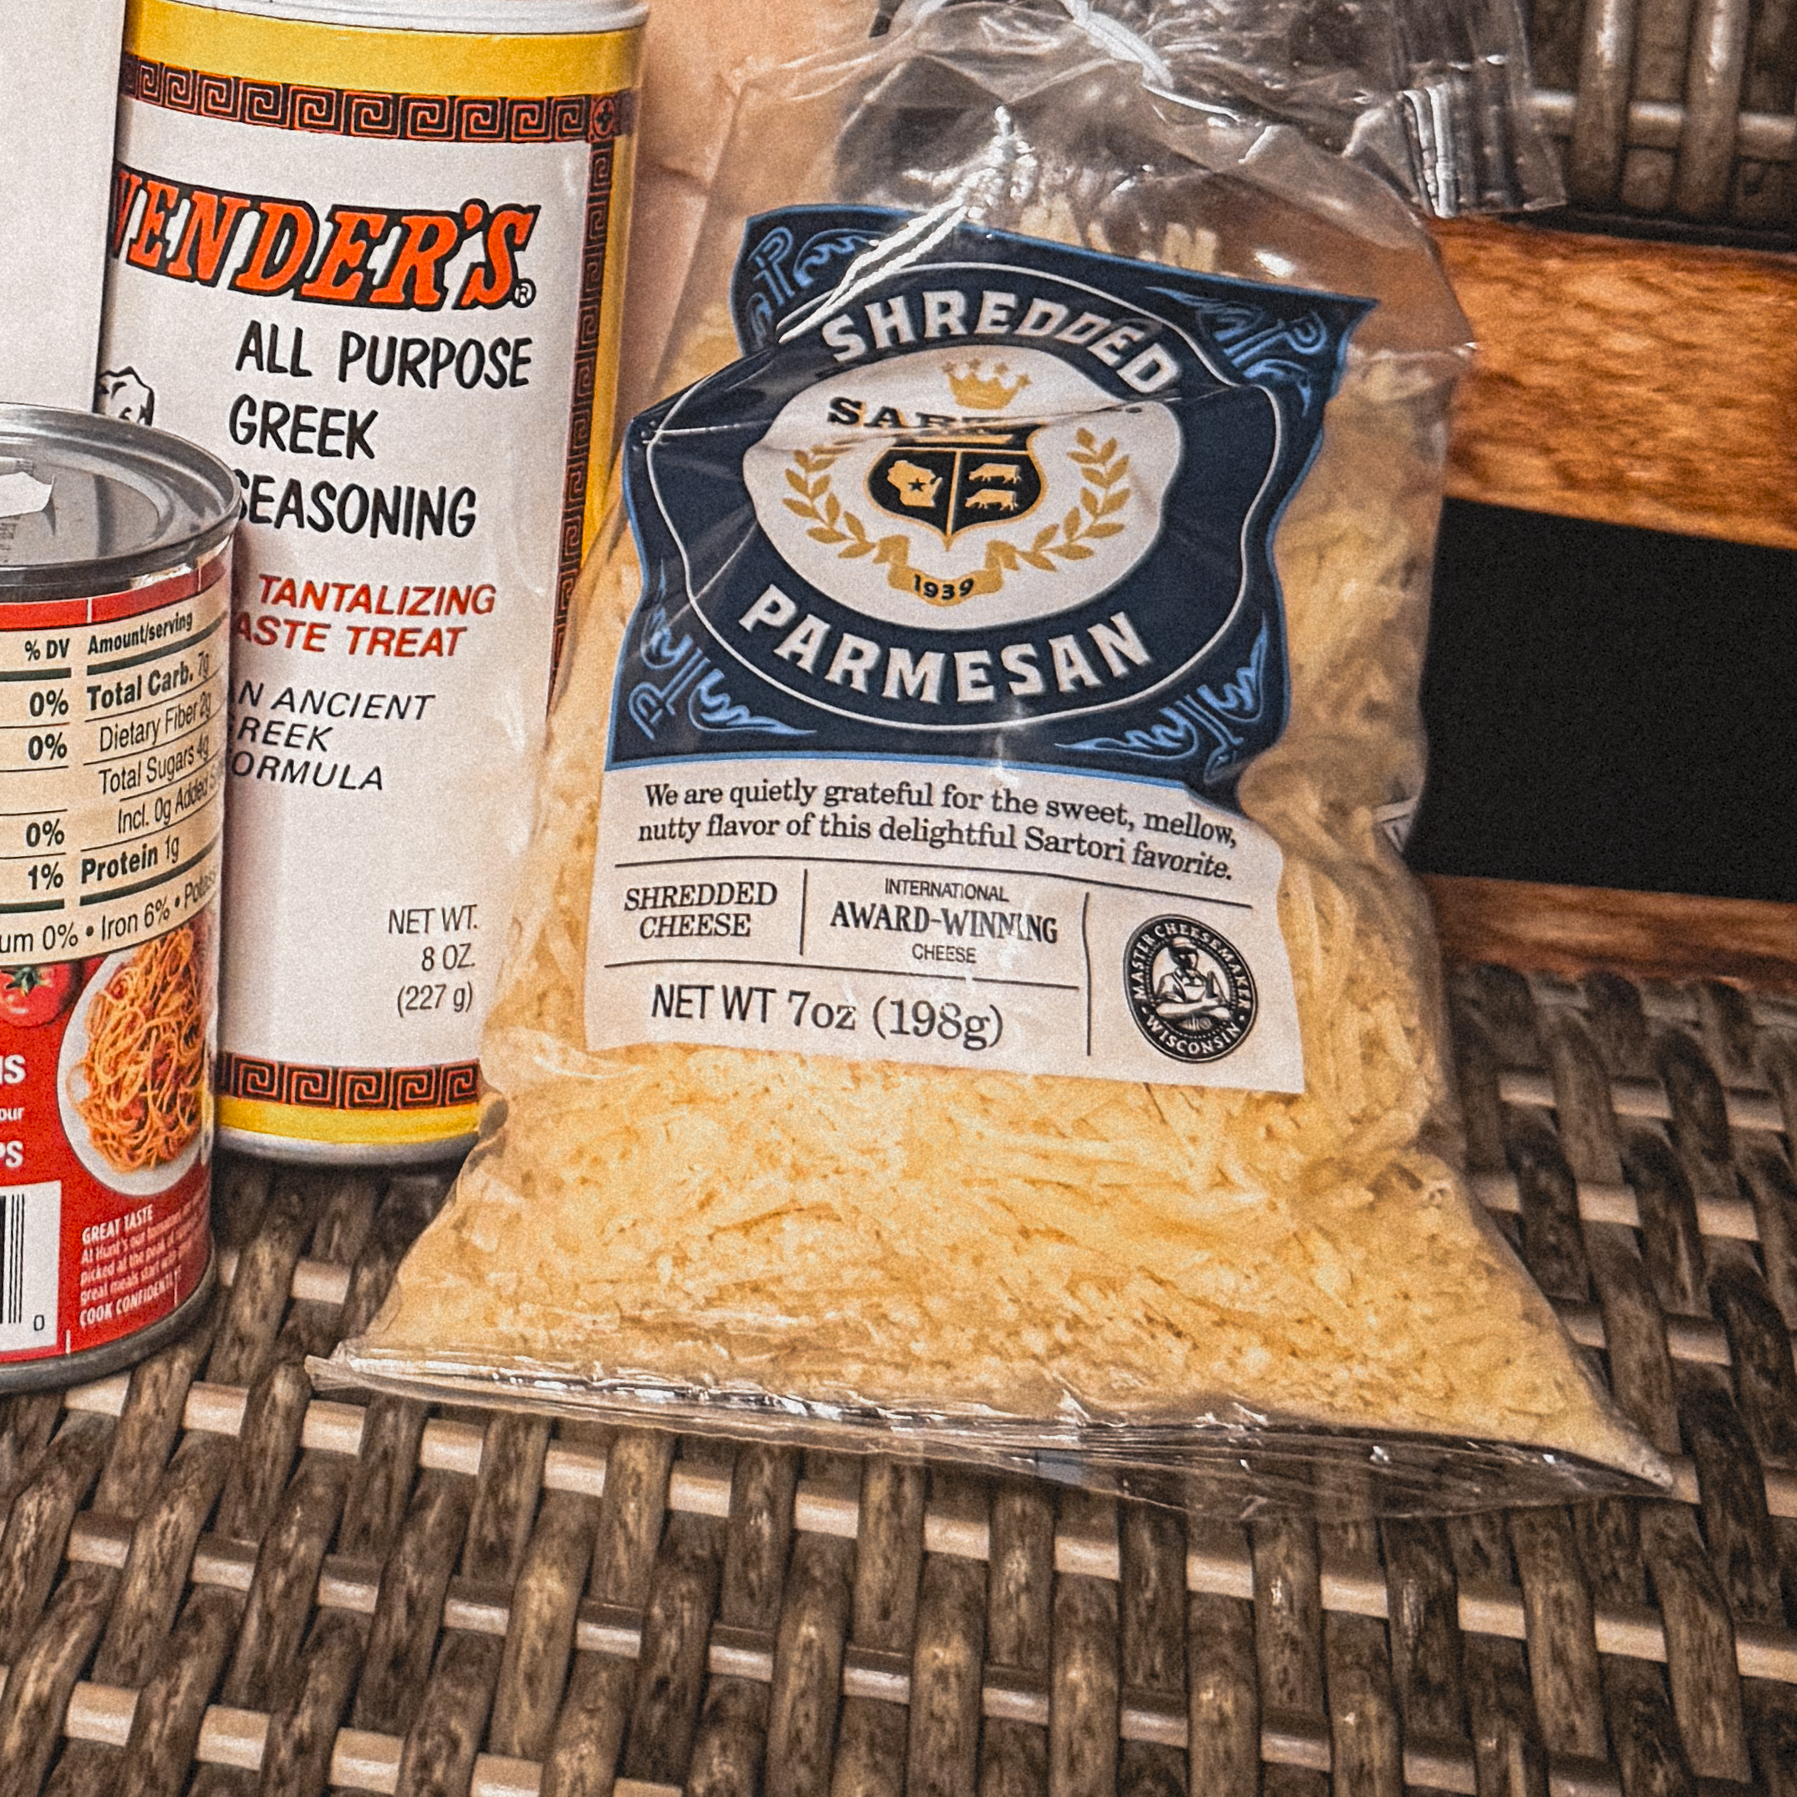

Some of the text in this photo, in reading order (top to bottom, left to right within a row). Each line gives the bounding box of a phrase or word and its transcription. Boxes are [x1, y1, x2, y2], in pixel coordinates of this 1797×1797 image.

[235, 320, 533, 389] ALL PURPOSE
[821, 290, 1183, 393] SHREDDED
[229, 395, 379, 460] GREEK
[258, 574, 497, 616] TANTALIZING
[913, 574, 975, 600] 1939
[25, 640, 40, 661] %
[45, 638, 69, 659] DV
[88, 611, 193, 655] Amount/serving
[346, 626, 467, 658] TREAT
[738, 583, 1153, 703] PARMESAN
[29, 690, 69, 717] 0%
[87, 661, 193, 711] Total Carb.
[271, 687, 435, 721] ANCIENT
[100, 701, 197, 752] Dietary Fiber
[28, 734, 67, 760] 0%
[98, 760, 141, 792] Total
[147, 745, 194, 783] Sugars
[118, 803, 149, 834] Incl.
[155, 797, 171, 825] 0g
[645, 778, 1238, 850] We are quietly grateful for the sweet, mellow,
[26, 820, 65, 847] 0%
[638, 812, 1233, 882] nutty flavor of this delightful Sartori favorite.
[28, 864, 64, 890] 1%
[81, 834, 179, 884] Protein 1g
[624, 882, 777, 909] SHREDDED
[884, 877, 1009, 904] INTERNATIONAL
[42, 925, 79, 952] 0%
[102, 915, 138, 941] Iron
[144, 895, 170, 928] 6%
[388, 904, 478, 934] NET WT.
[639, 912, 752, 940] CHEESE
[830, 904, 1057, 945] AWARD-WINNING
[421, 943, 475, 971] 8 OZ.
[912, 944, 976, 965] CHEESE
[1131, 934, 1155, 1000] MASTER
[398, 982, 474, 1018] (227 g)
[650, 983, 1004, 1051] NET WT 7oz (198g)
[1146, 1015, 1241, 1054] WISCONSIN
[82, 1218, 120, 1245] GREAT
[124, 1204, 153, 1231] TASTE
[34, 1314, 45, 1331] 0
[80, 1302, 112, 1327] COOK
